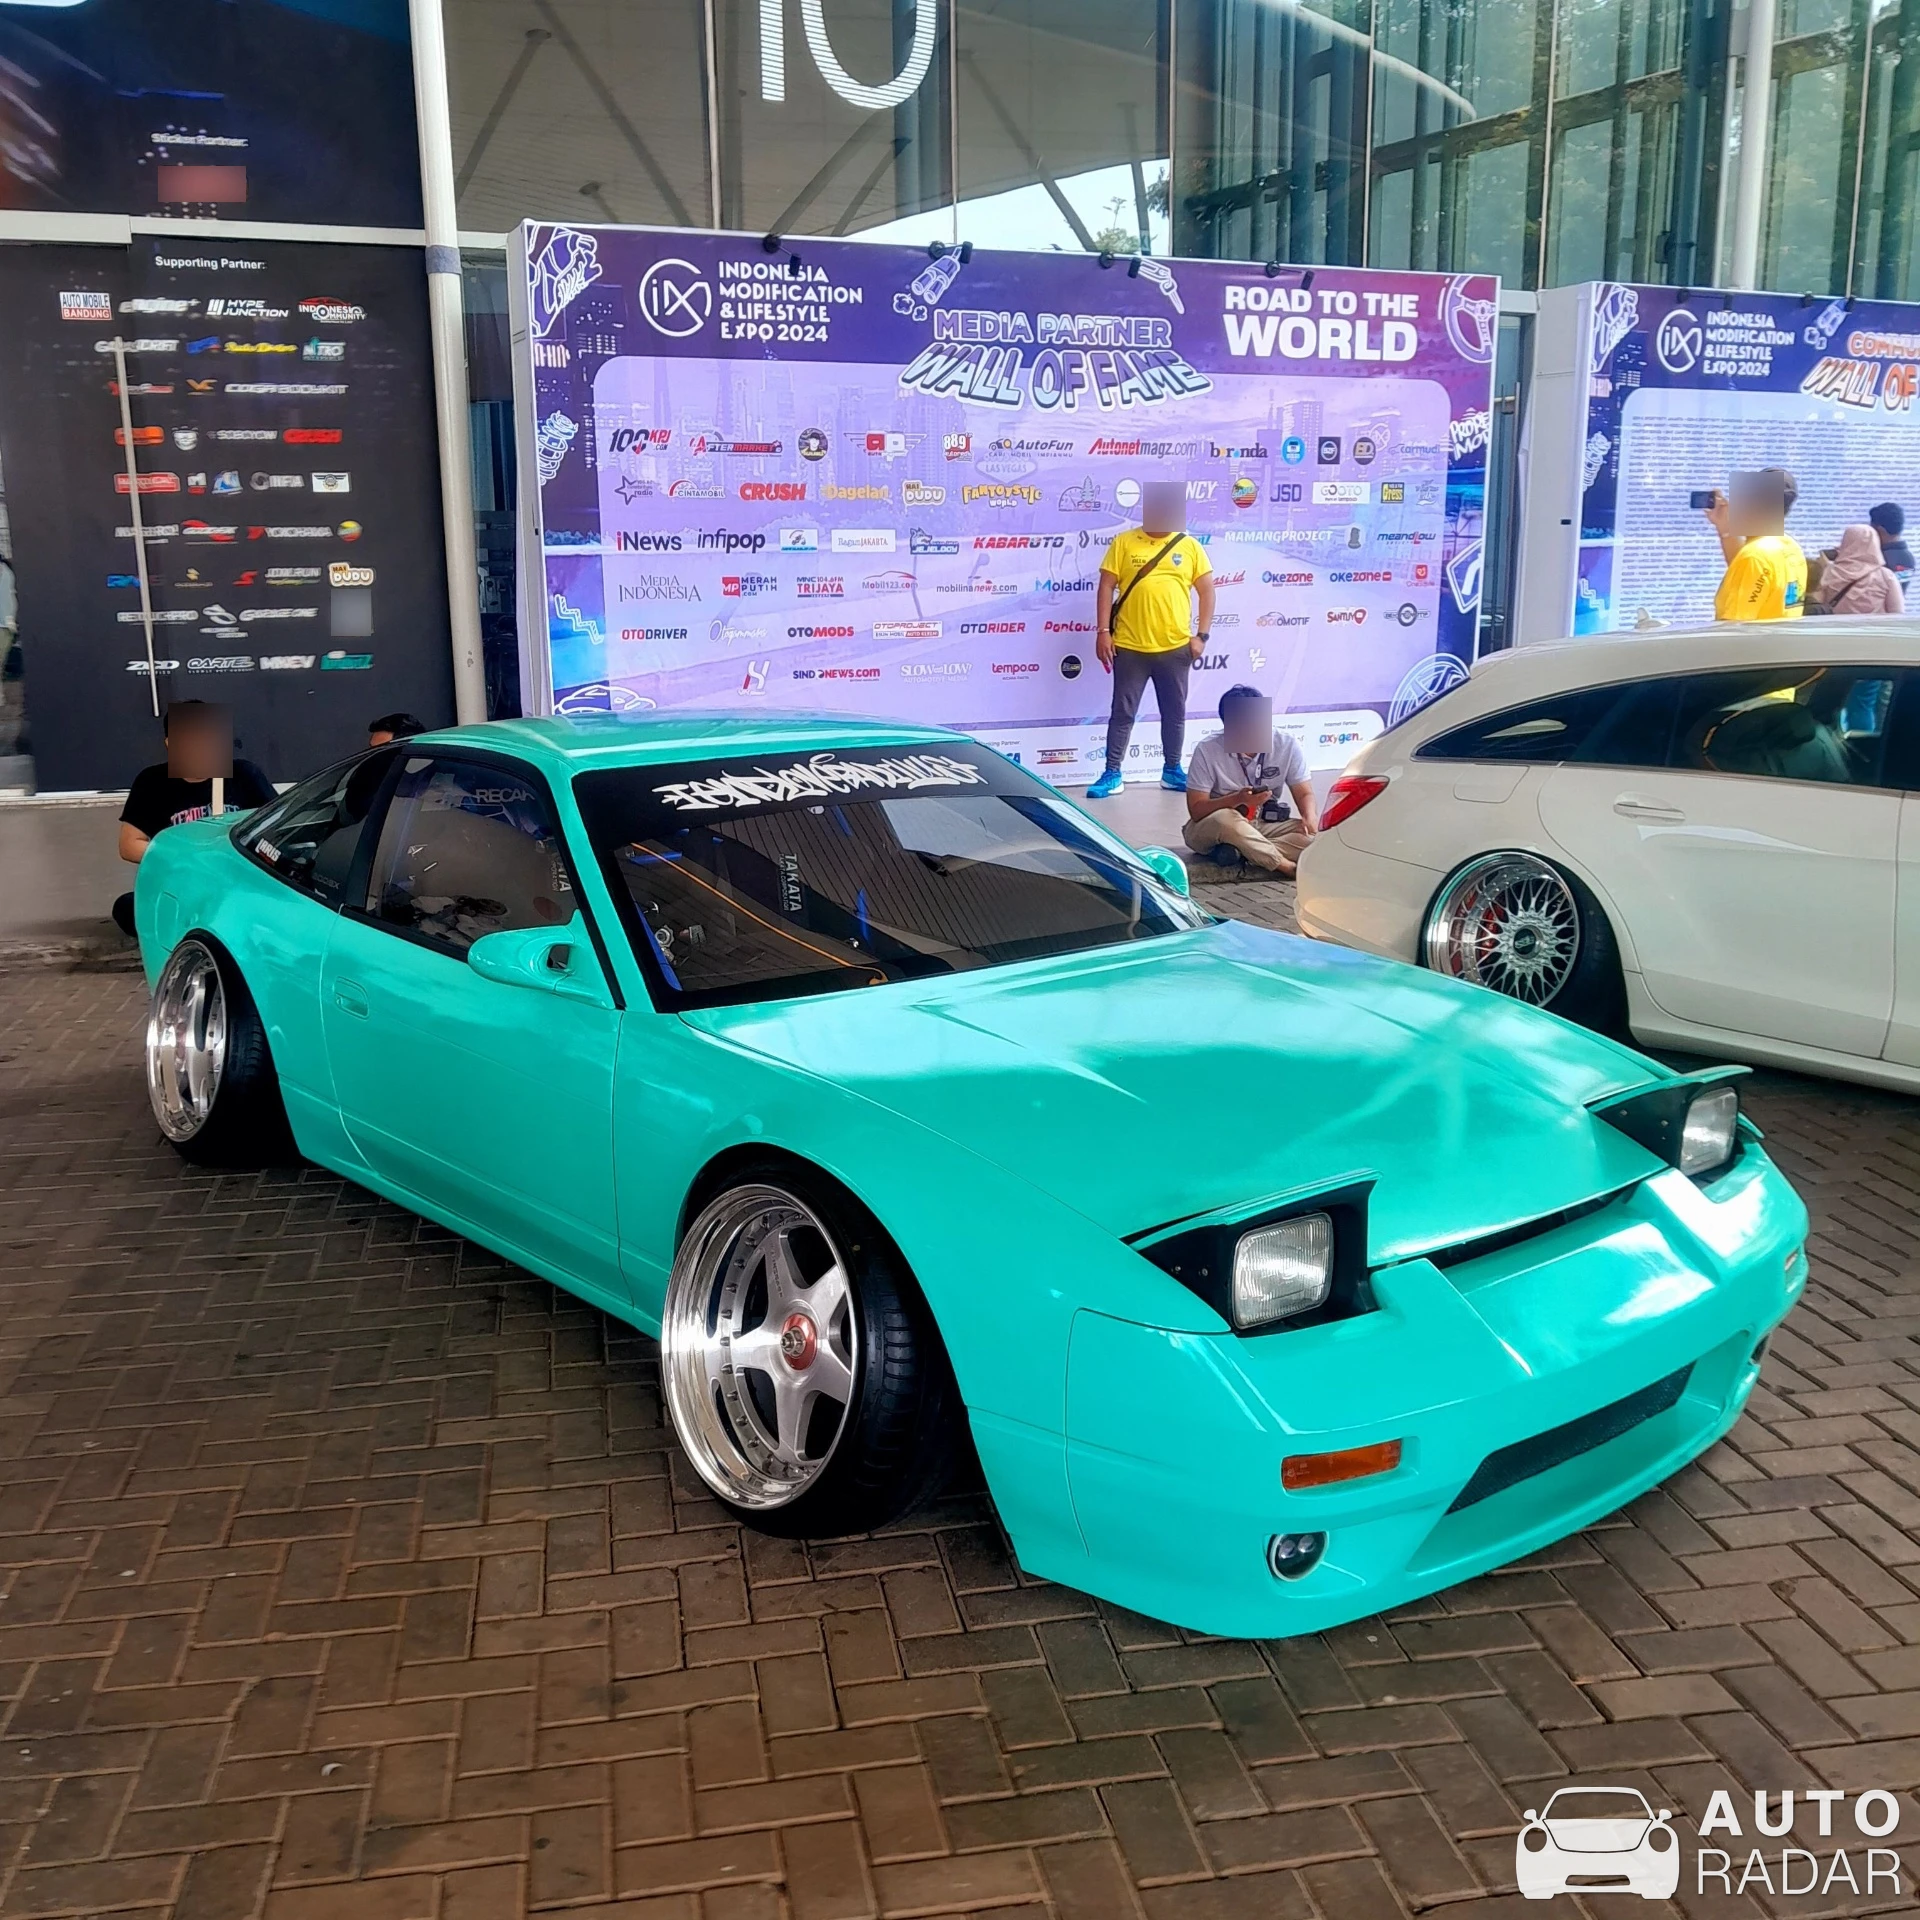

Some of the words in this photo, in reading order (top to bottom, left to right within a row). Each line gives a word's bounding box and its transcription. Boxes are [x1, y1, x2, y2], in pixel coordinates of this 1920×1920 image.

[155, 256, 218, 271] Supporting
[220, 258, 266, 271] Partner:
[719, 282, 863, 304] MODIFICATION
[62, 293, 82, 308] AUTO
[84, 294, 109, 309] MOBILE
[228, 300, 264, 308] HYPE
[1224, 285, 1312, 312] ROAD
[1318, 289, 1358, 315] TO
[1363, 292, 1420, 318] THE
[63, 308, 110, 319] BANDUNG
[223, 309, 288, 318] JUNCTION
[720, 302, 735, 319] &
[738, 303, 831, 322] LIFESTYLE
[1706, 311, 1775, 328] INDONESIA
[720, 322, 774, 341] EXPO
[777, 324, 829, 342] 2024
[934, 310, 1033, 343] MEDIA
[1037, 313, 1172, 347] PARTNER
[1222, 314, 1418, 362] WORLD
[1705, 328, 1795, 345] MODIFICATION
[1716, 345, 1773, 360] LIFESTYLE
[1703, 361, 1736, 374] EXPO
[1737, 363, 1770, 376] 2024
[900, 343, 1025, 411] WALL
[1031, 348, 1088, 412] OF
[1088, 350, 1213, 411] FAME
[1801, 358, 1880, 410] WALL
[1883, 364, 1918, 411] OF
[1015, 439, 1073, 451] AutoFun
[1088, 437, 1198, 459] Autonetmagz.com
[740, 482, 807, 501] CRUSH
[906, 490, 943, 502] DUDU
[616, 531, 682, 551] iNews
[697, 528, 766, 553] infipop
[973, 536, 1065, 549] KABAROTO
[1224, 530, 1333, 542] MAMANGPROJECT
[334, 572, 371, 584] DUDU
[862, 580, 918, 590] Mobil123.com
[1035, 578, 1094, 592] Moladin
[619, 585, 702, 602] INDONESIA
[797, 583, 844, 593] TRIJAYA
[787, 626, 854, 638] OTOMODS
[874, 622, 939, 630] OTOPROJECT
[960, 622, 1026, 634] OTORIDER
[621, 628, 688, 640] OTODRIVER
[785, 853, 802, 911] TAKATA
